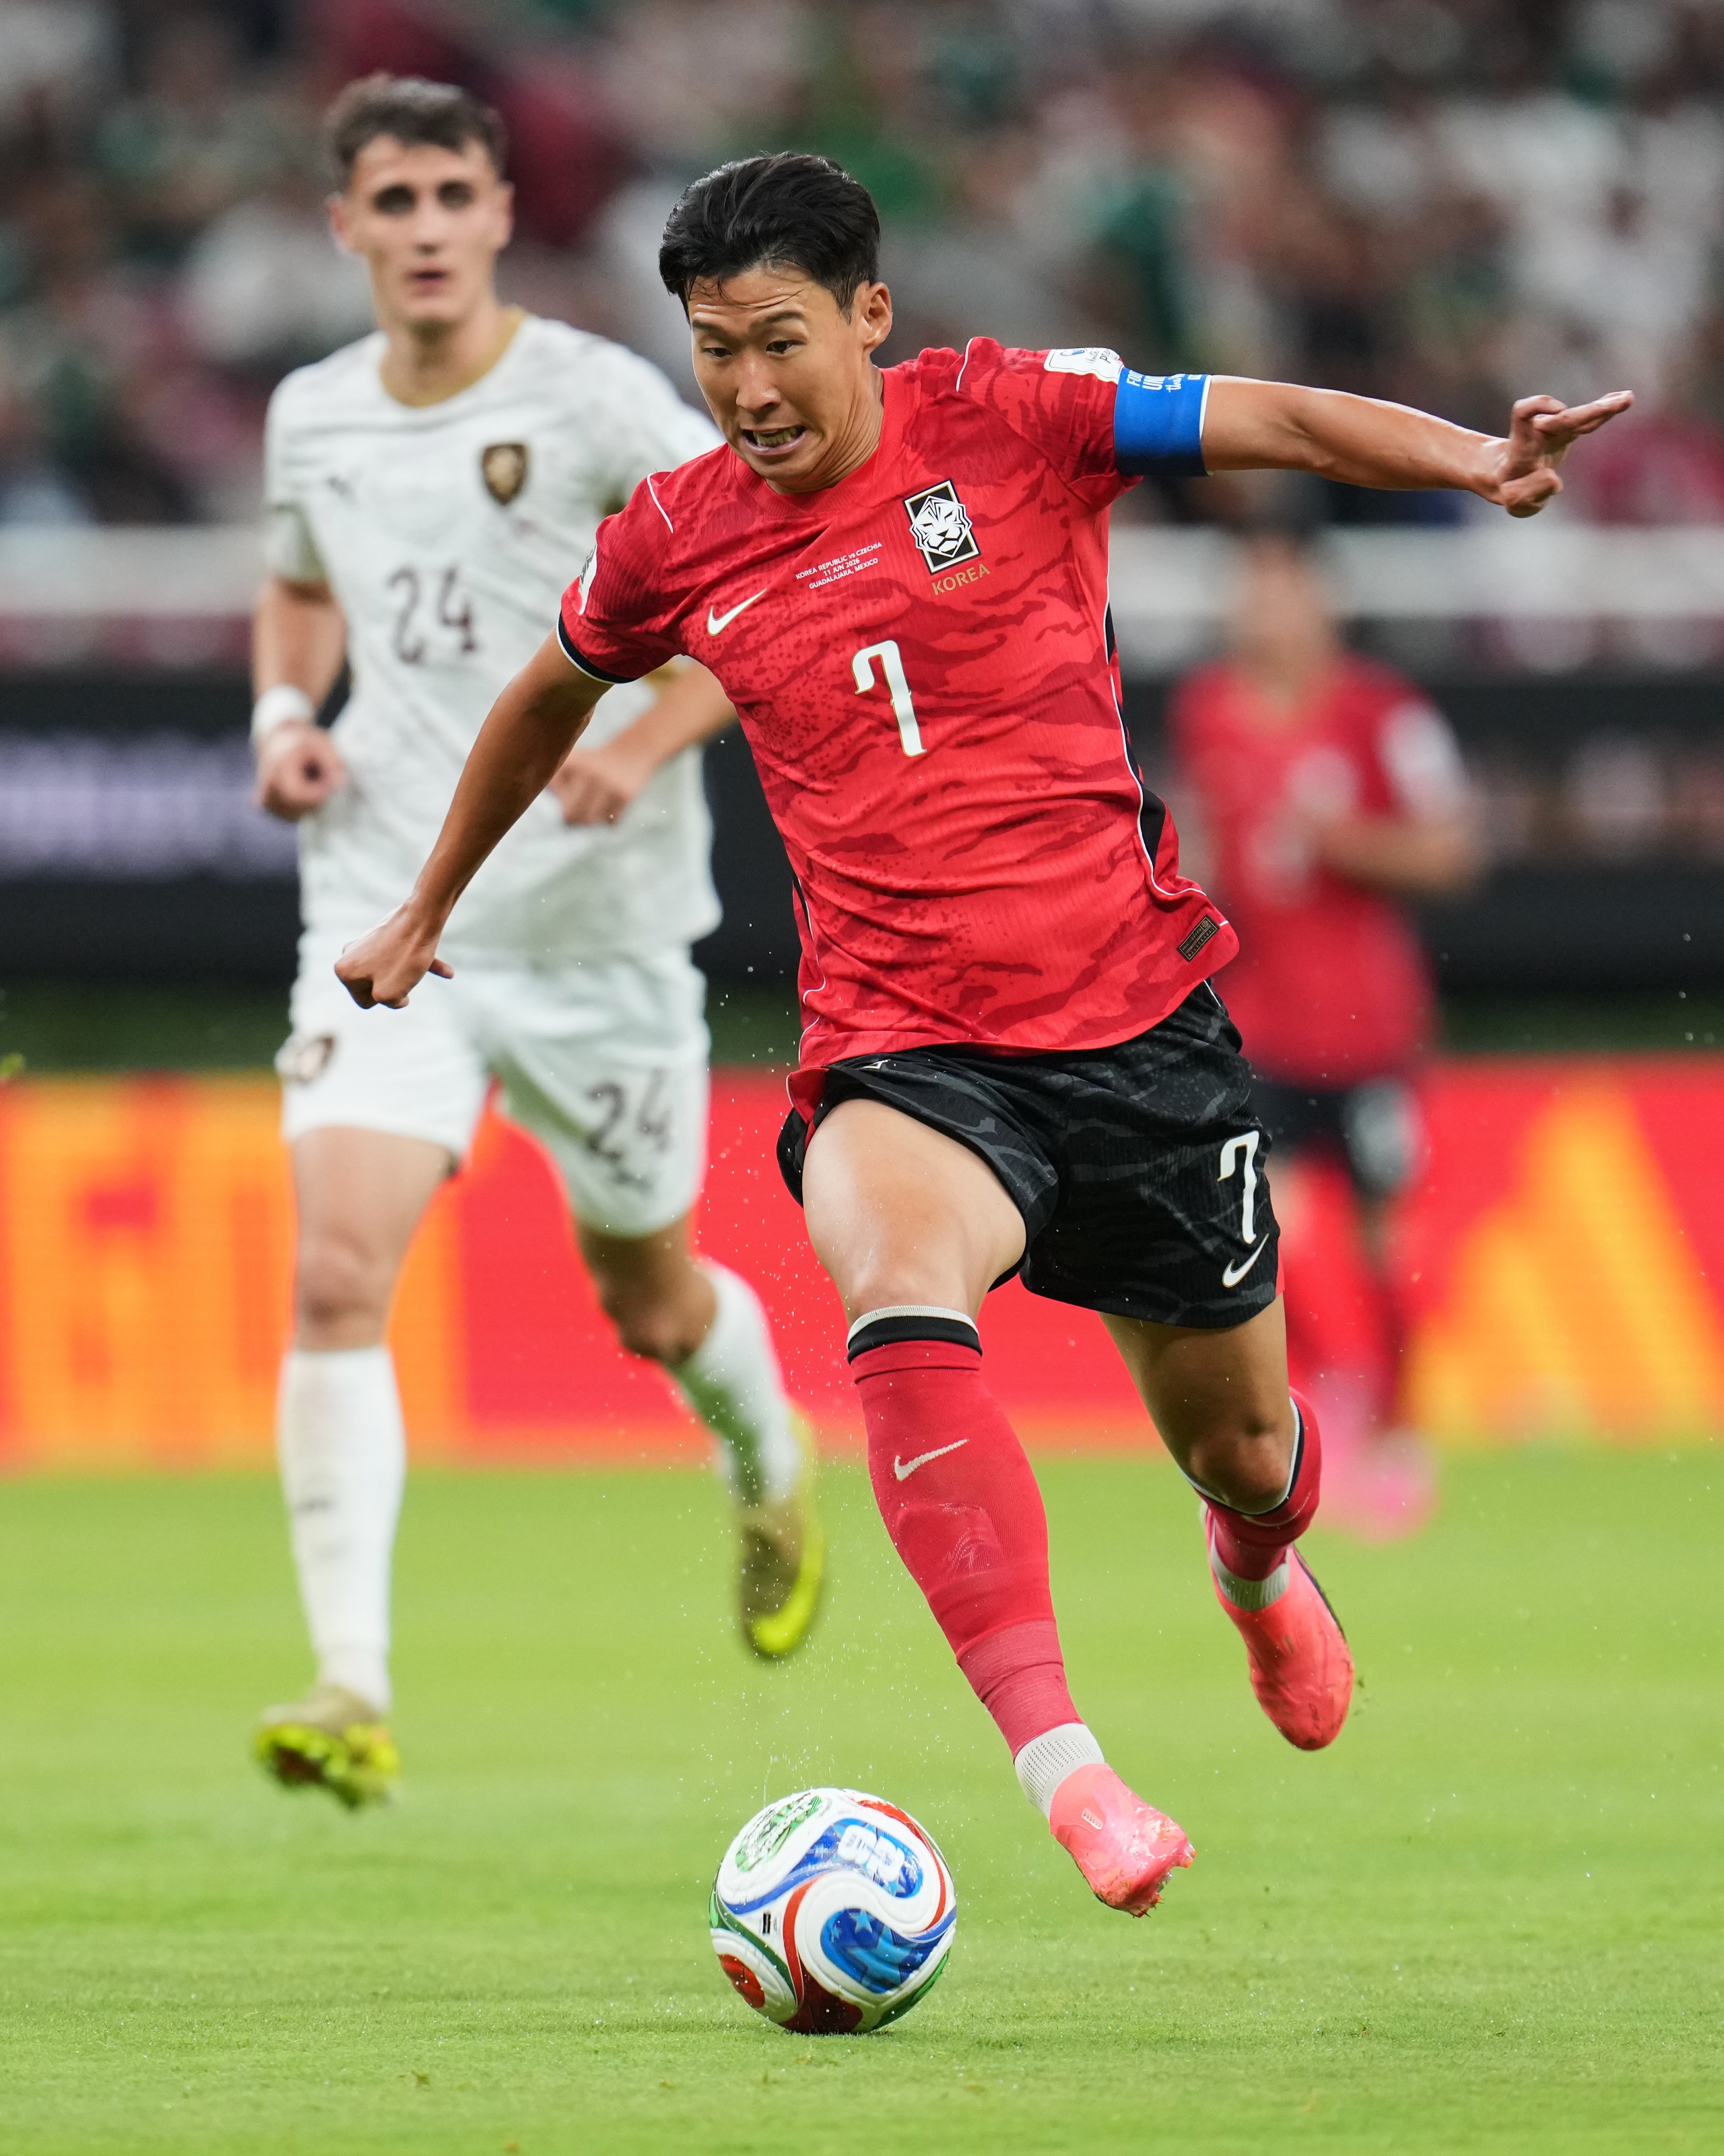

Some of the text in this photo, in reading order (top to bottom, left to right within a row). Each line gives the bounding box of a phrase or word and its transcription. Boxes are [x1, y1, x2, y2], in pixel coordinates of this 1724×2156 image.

[795, 567, 818, 579] KOREA
[818, 555, 848, 571] REPUBLIC
[856, 542, 882, 556] CZECHIA
[809, 558, 878, 589] GUADALAJARA, MEXICO
[832, 564, 844, 573] JUN
[846, 558, 860, 568] 2026
[931, 563, 991, 595] KOREA
[387, 562, 479, 665] 24
[851, 639, 928, 758] 7
[586, 1066, 673, 1167] 24
[1217, 1130, 1259, 1244] 7
